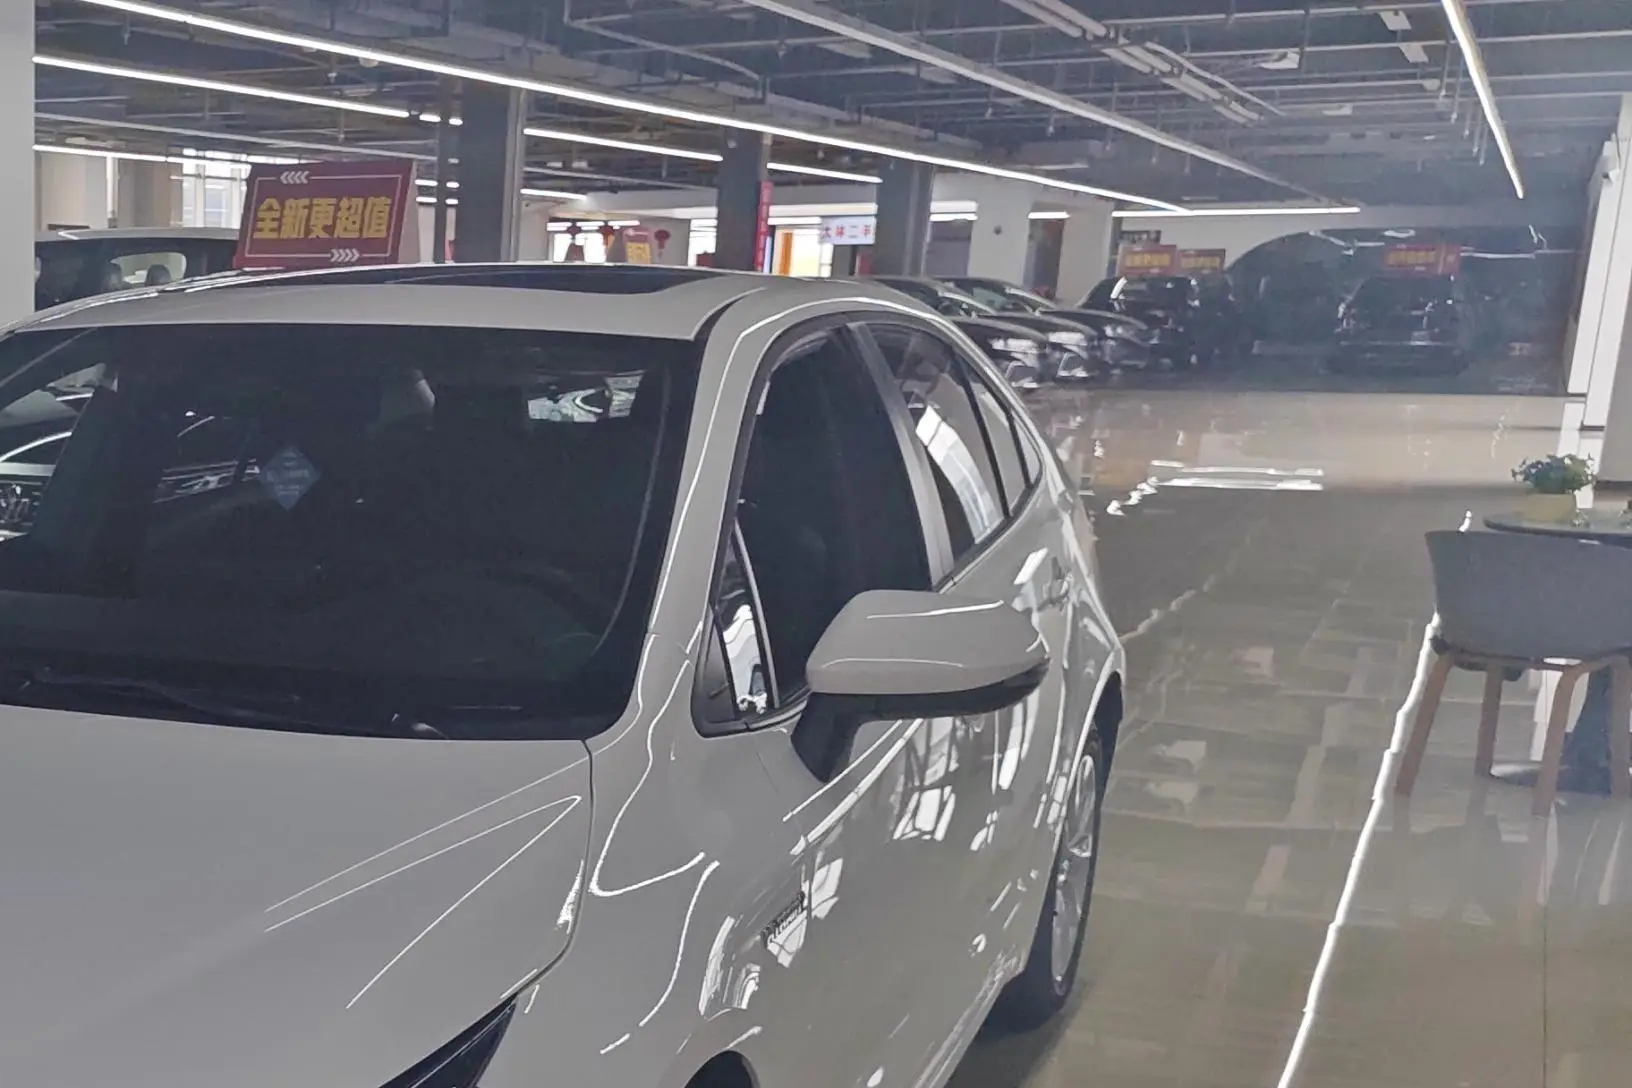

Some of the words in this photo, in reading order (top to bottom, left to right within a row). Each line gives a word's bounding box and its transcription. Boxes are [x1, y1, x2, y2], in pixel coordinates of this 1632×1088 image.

[253, 196, 392, 240] 全新更超值
